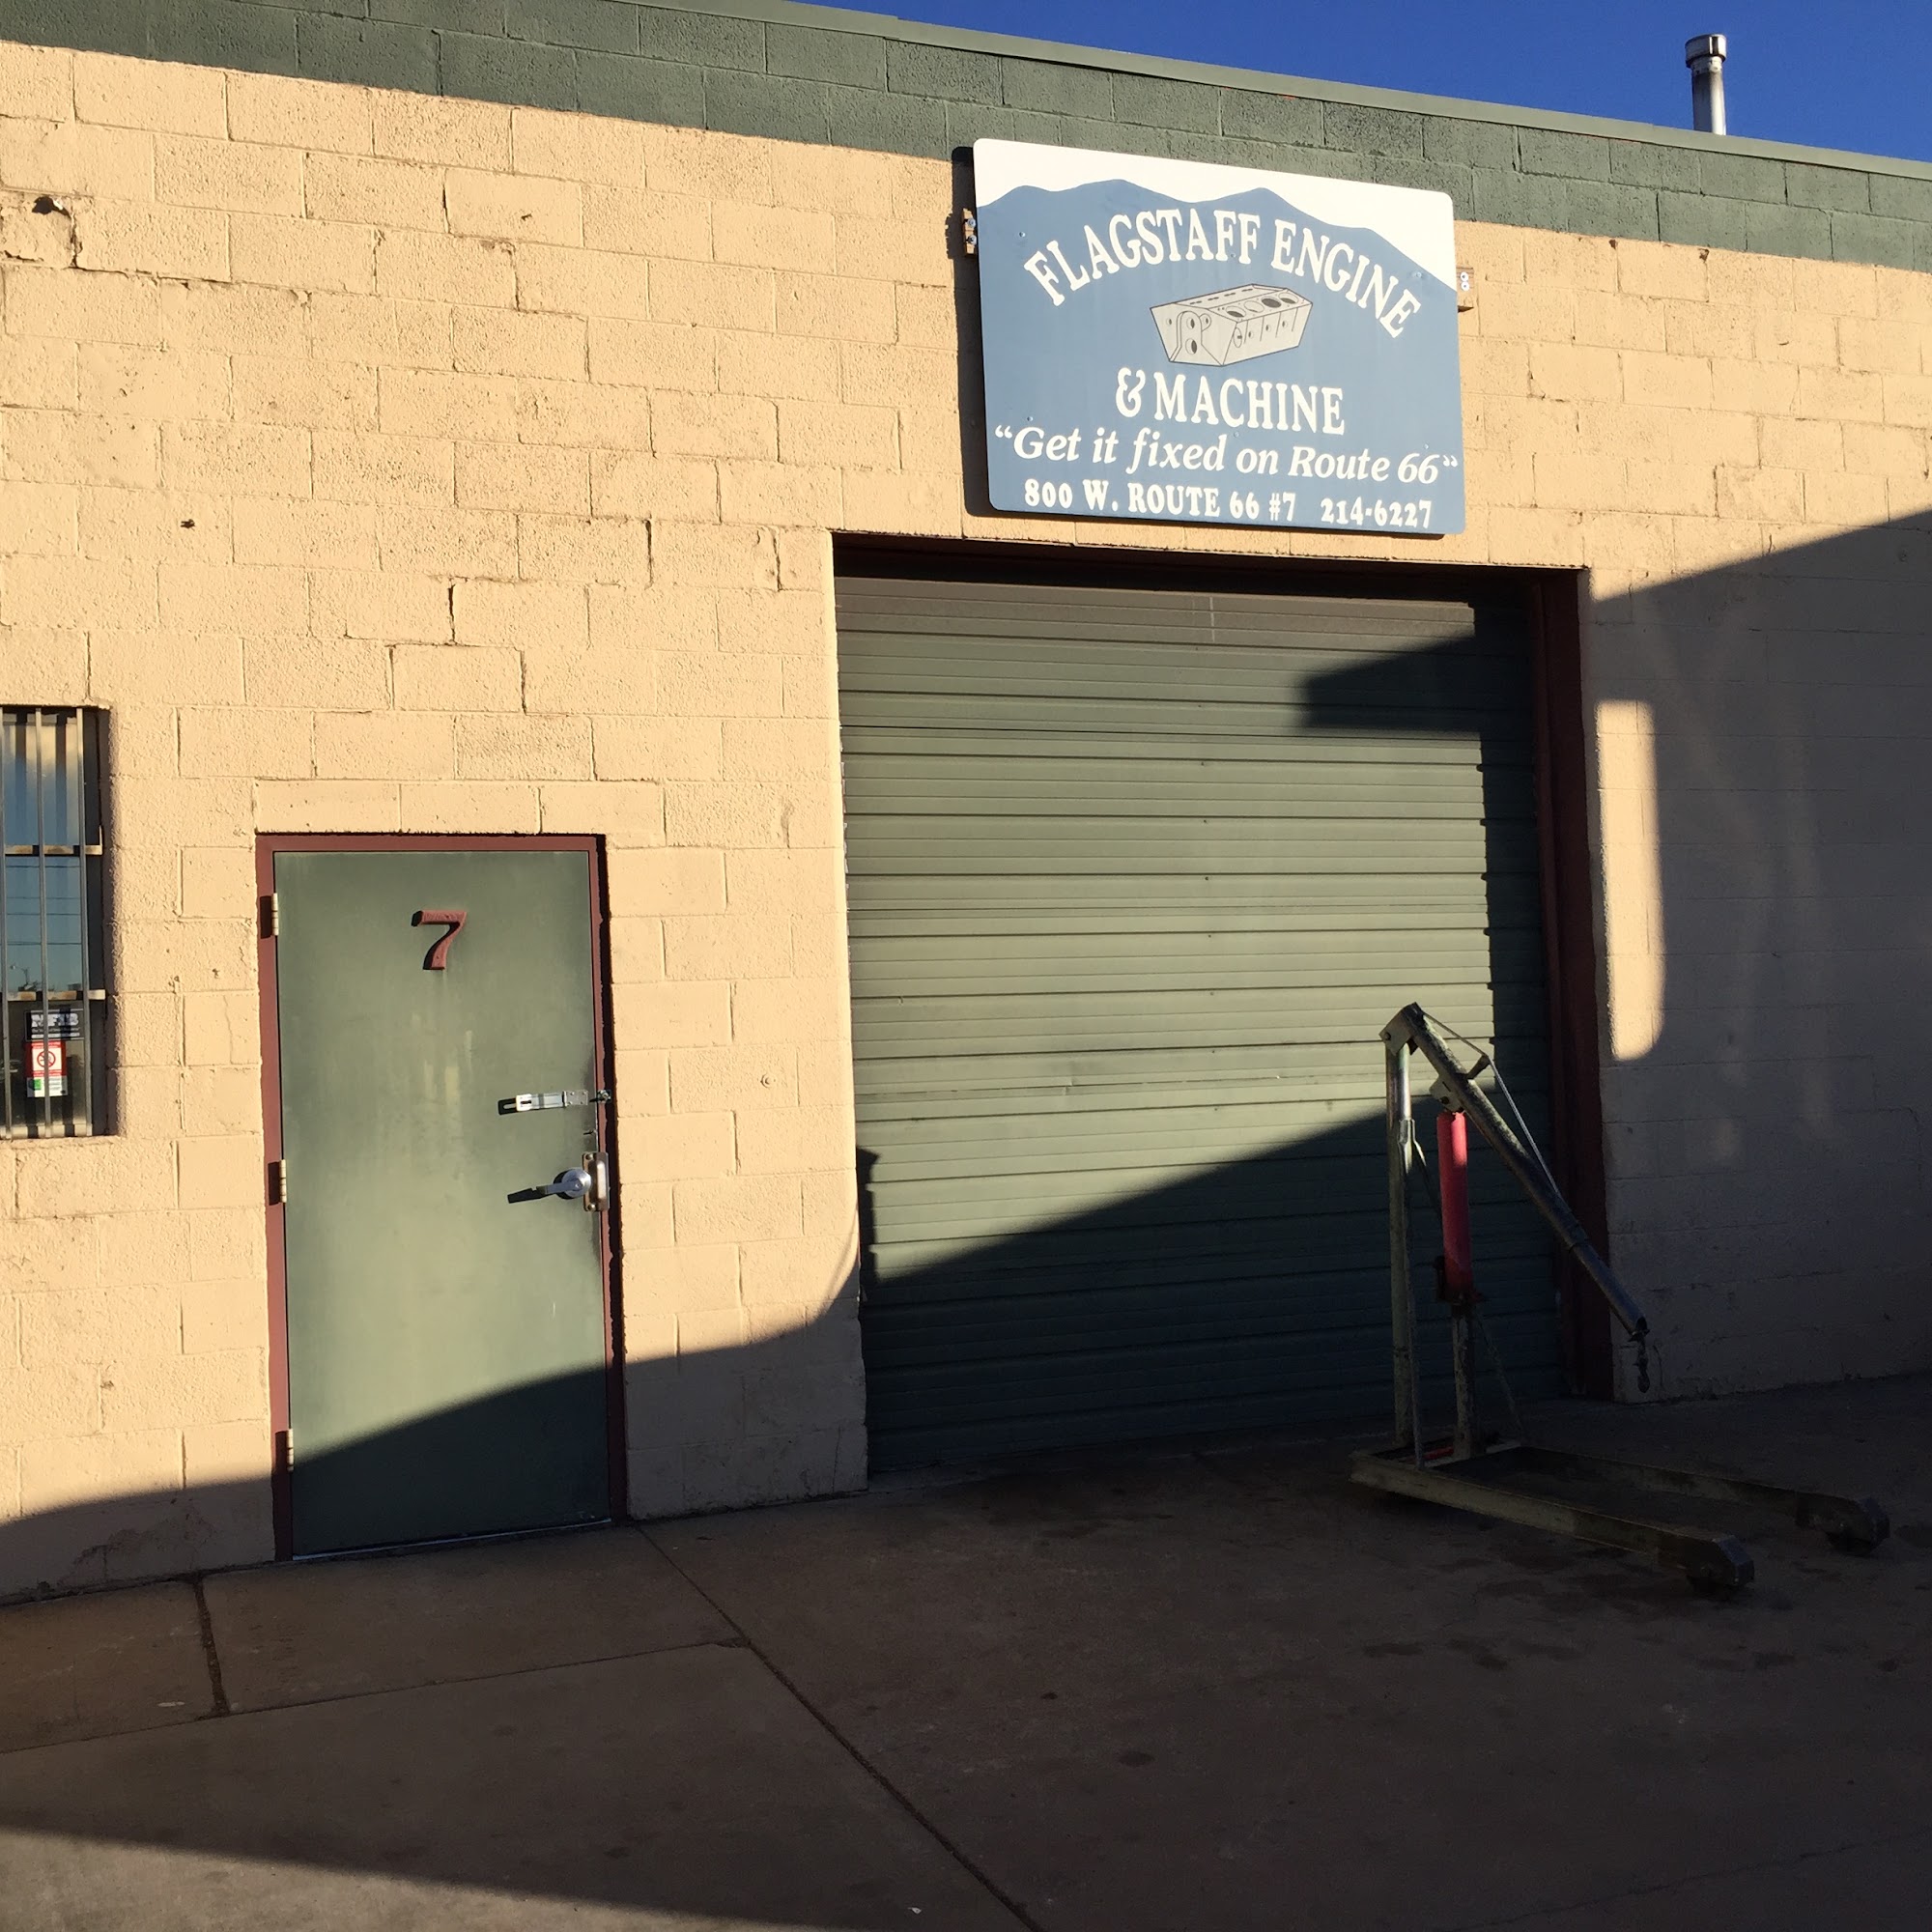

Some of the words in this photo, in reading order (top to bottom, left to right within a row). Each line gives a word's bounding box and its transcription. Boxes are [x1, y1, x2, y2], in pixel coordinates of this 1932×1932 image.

[1024, 208, 1261, 305] FLAGSTAFF
[1270, 218, 1422, 338] ENGINE
[1116, 367, 1146, 417] &
[1153, 371, 1346, 436] MACHINE
[1092, 428, 1119, 464] it
[1125, 427, 1228, 474] fixed
[1236, 447, 1279, 475] on
[1288, 446, 1391, 483] Route
[1024, 478, 1073, 509] 800
[1082, 479, 1119, 512] W.
[1126, 483, 1220, 518] ROUTE
[1229, 491, 1261, 521] 66
[1268, 493, 1296, 522] #7
[1320, 497, 1433, 528] 214-6227
[412, 909, 468, 970] 7
